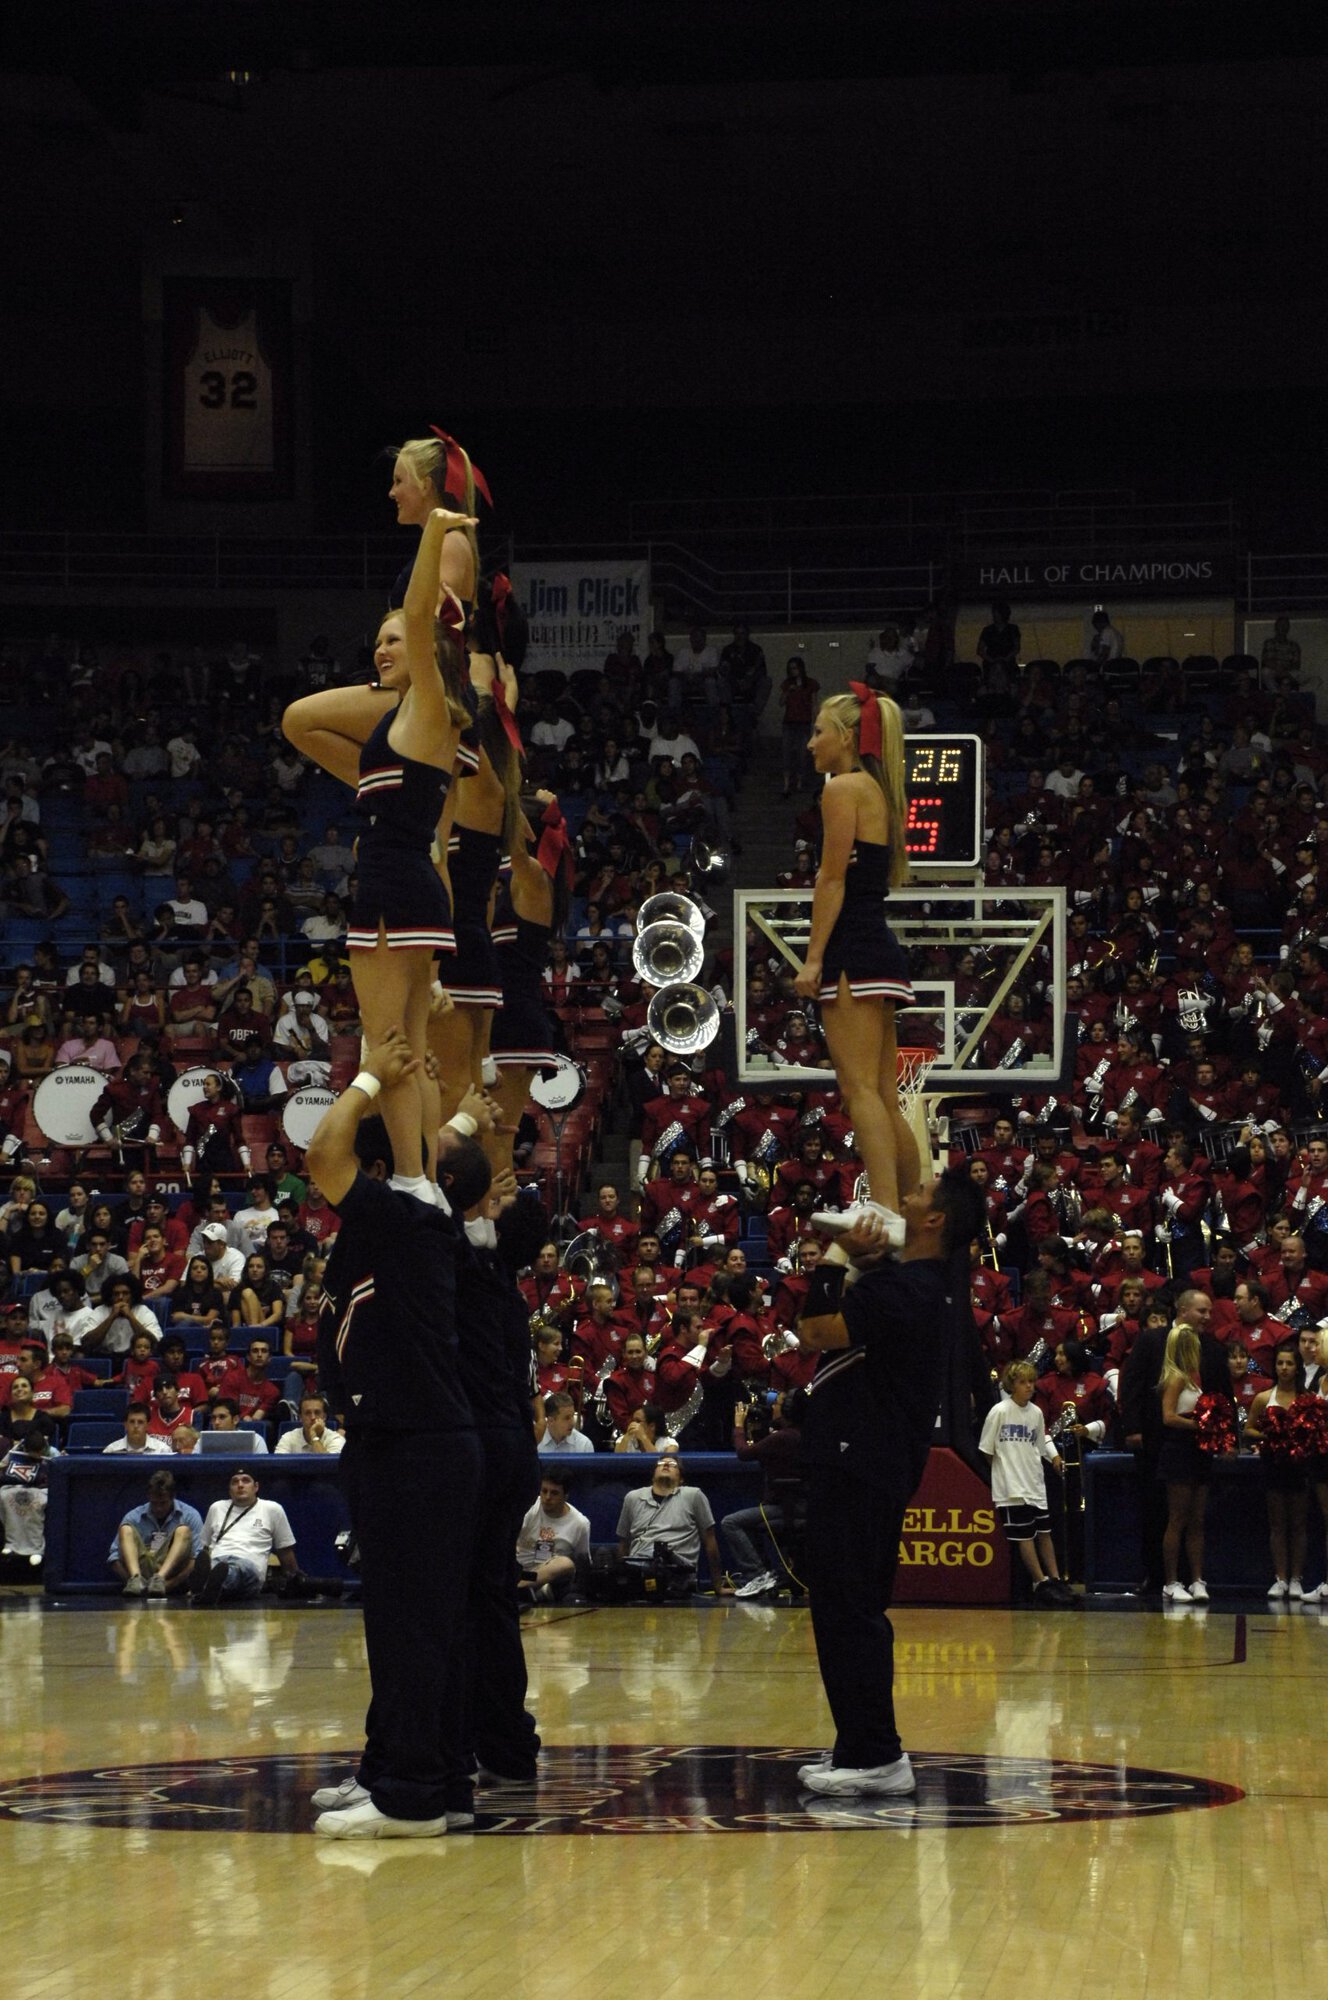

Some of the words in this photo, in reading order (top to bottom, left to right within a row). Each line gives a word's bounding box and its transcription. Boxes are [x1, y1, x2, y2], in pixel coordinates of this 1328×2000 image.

[204, 348, 253, 364] ELLIOTT
[200, 370, 258, 409] 32
[979, 567, 1035, 585] HALL
[1043, 565, 1071, 583] OF
[1080, 561, 1213, 582] CHAMPIONS
[522, 578, 568, 619] Jim
[577, 577, 641, 618] Click
[912, 749, 961, 782] 26
[905, 798, 942, 850] 5
[64, 1076, 95, 1085] YAMAHA
[304, 1096, 334, 1105] YAMAHA
[901, 1507, 997, 1535] ELLS
[897, 1541, 995, 1567] ARGO
